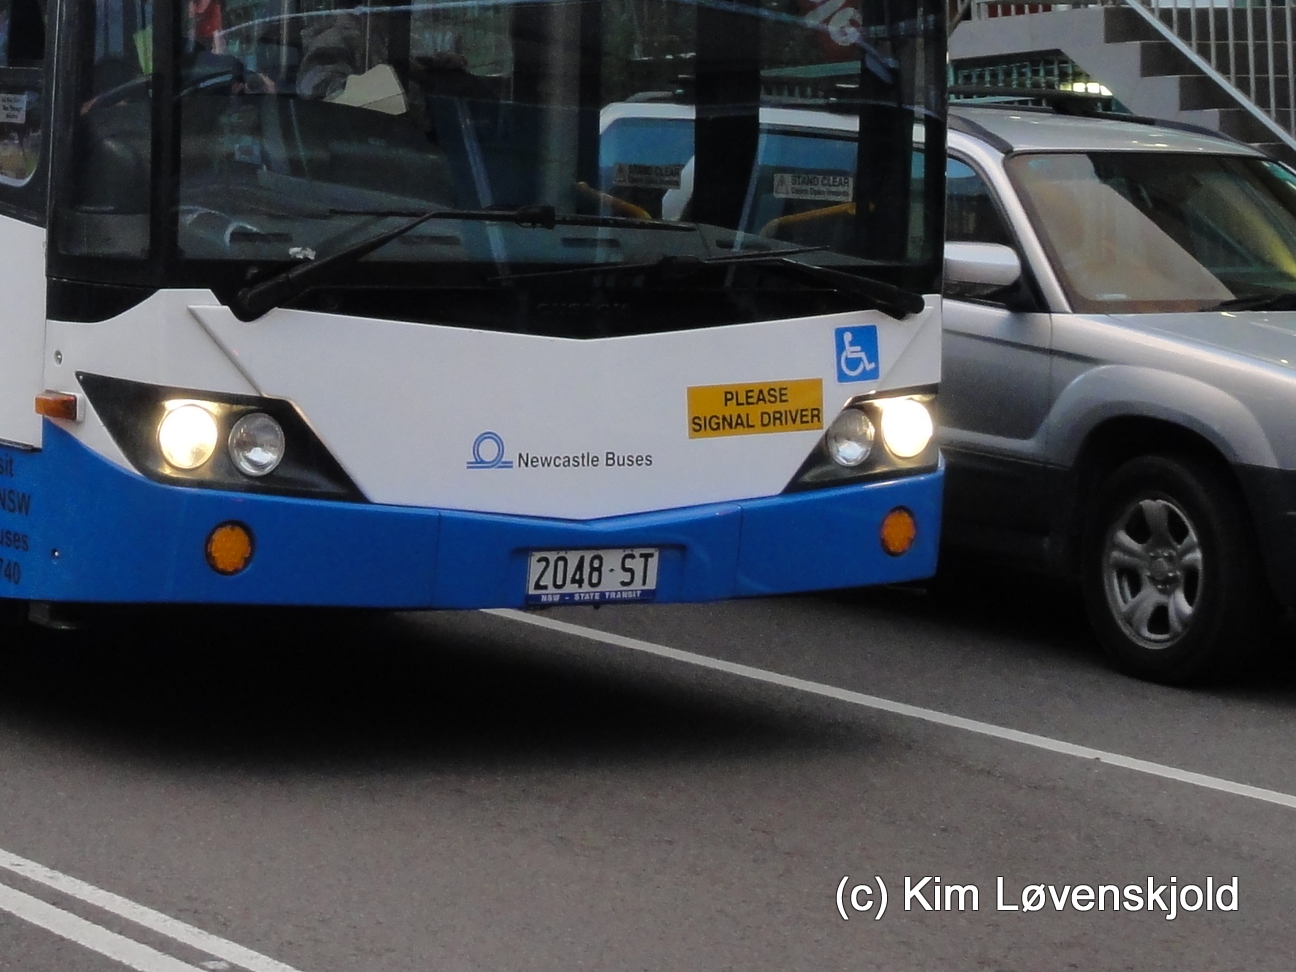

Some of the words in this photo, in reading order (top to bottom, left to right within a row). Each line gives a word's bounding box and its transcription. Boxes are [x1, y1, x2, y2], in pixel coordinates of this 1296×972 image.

[790, 174, 819, 186] STAND
[821, 176, 850, 188] CLEAR
[723, 387, 789, 407] PLEASE
[691, 414, 755, 432] SIGNAL
[760, 408, 821, 427] DRIVER
[517, 452, 600, 469] Newcastle
[605, 451, 653, 468] Buses
[540, 594, 561, 602] NSW
[573, 592, 601, 601] STATE
[605, 590, 642, 599] TRANSIT
